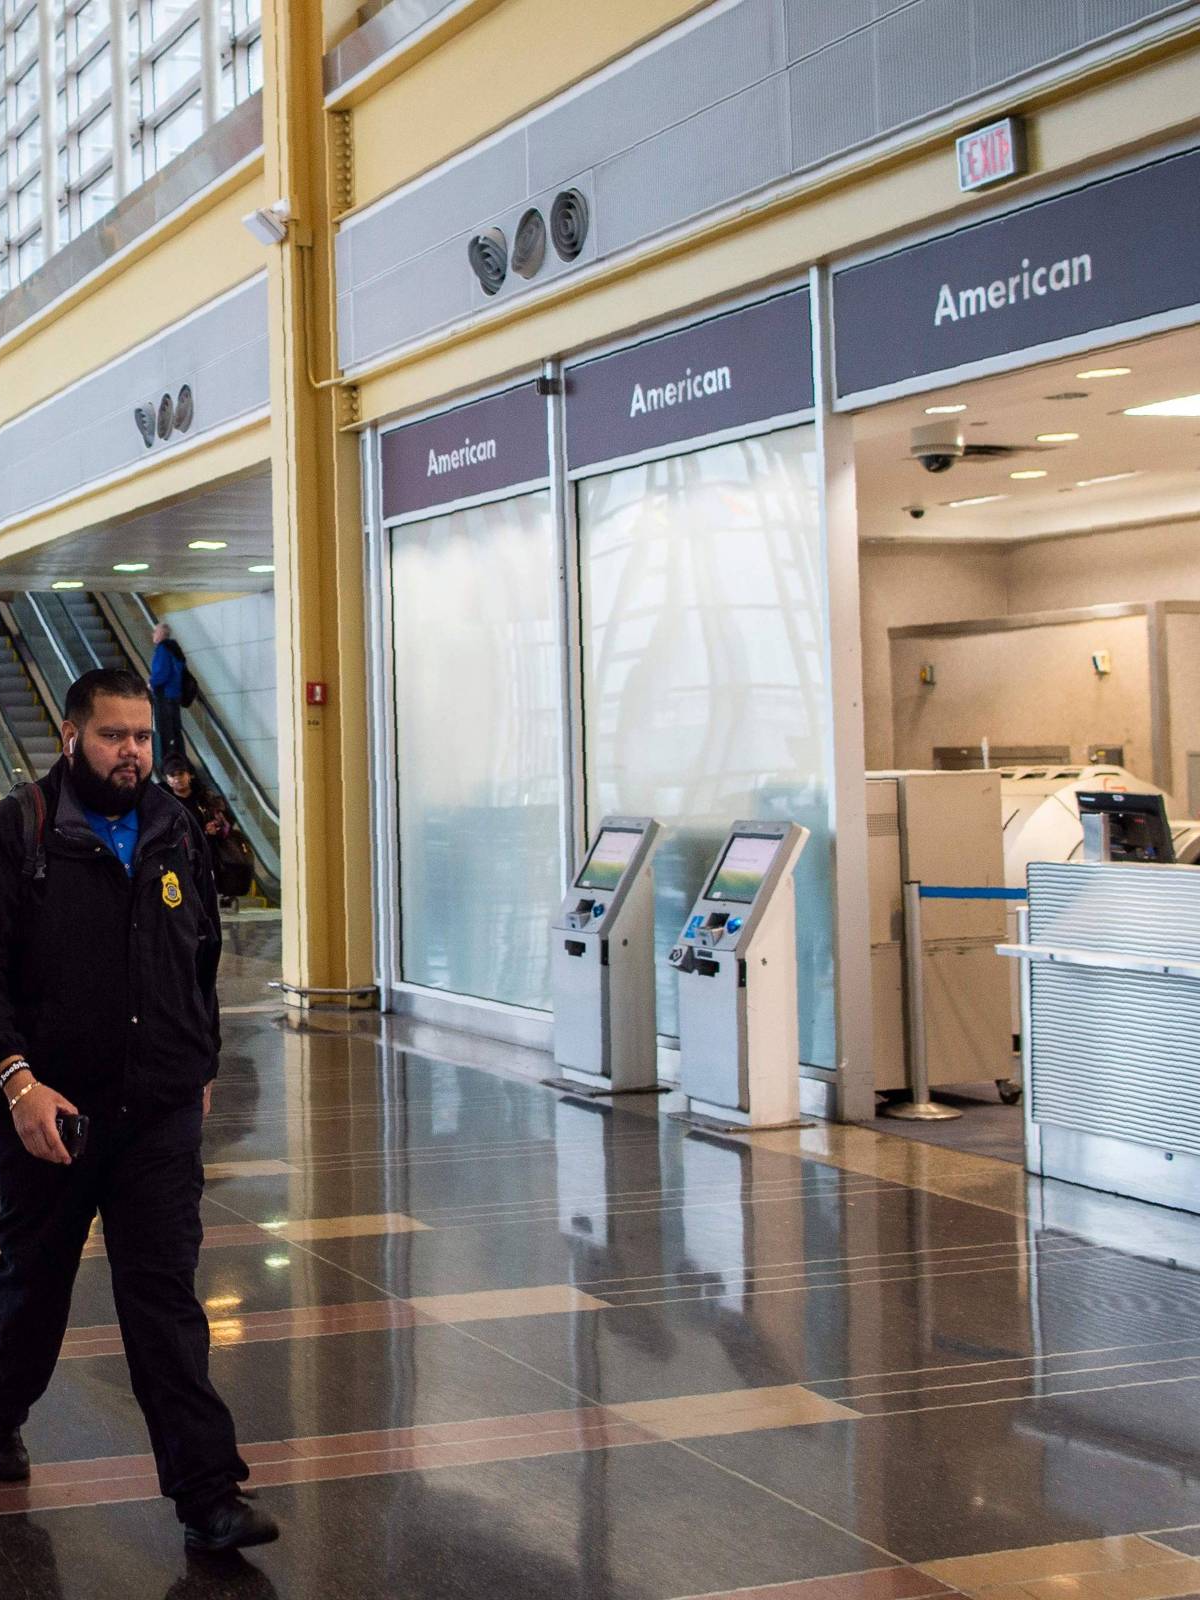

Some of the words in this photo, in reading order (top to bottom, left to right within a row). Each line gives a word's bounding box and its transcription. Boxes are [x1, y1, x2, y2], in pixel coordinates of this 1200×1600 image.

[967, 127, 1005, 182] EXIT
[934, 253, 1092, 327] American
[629, 365, 732, 419] American
[426, 437, 497, 478] American
